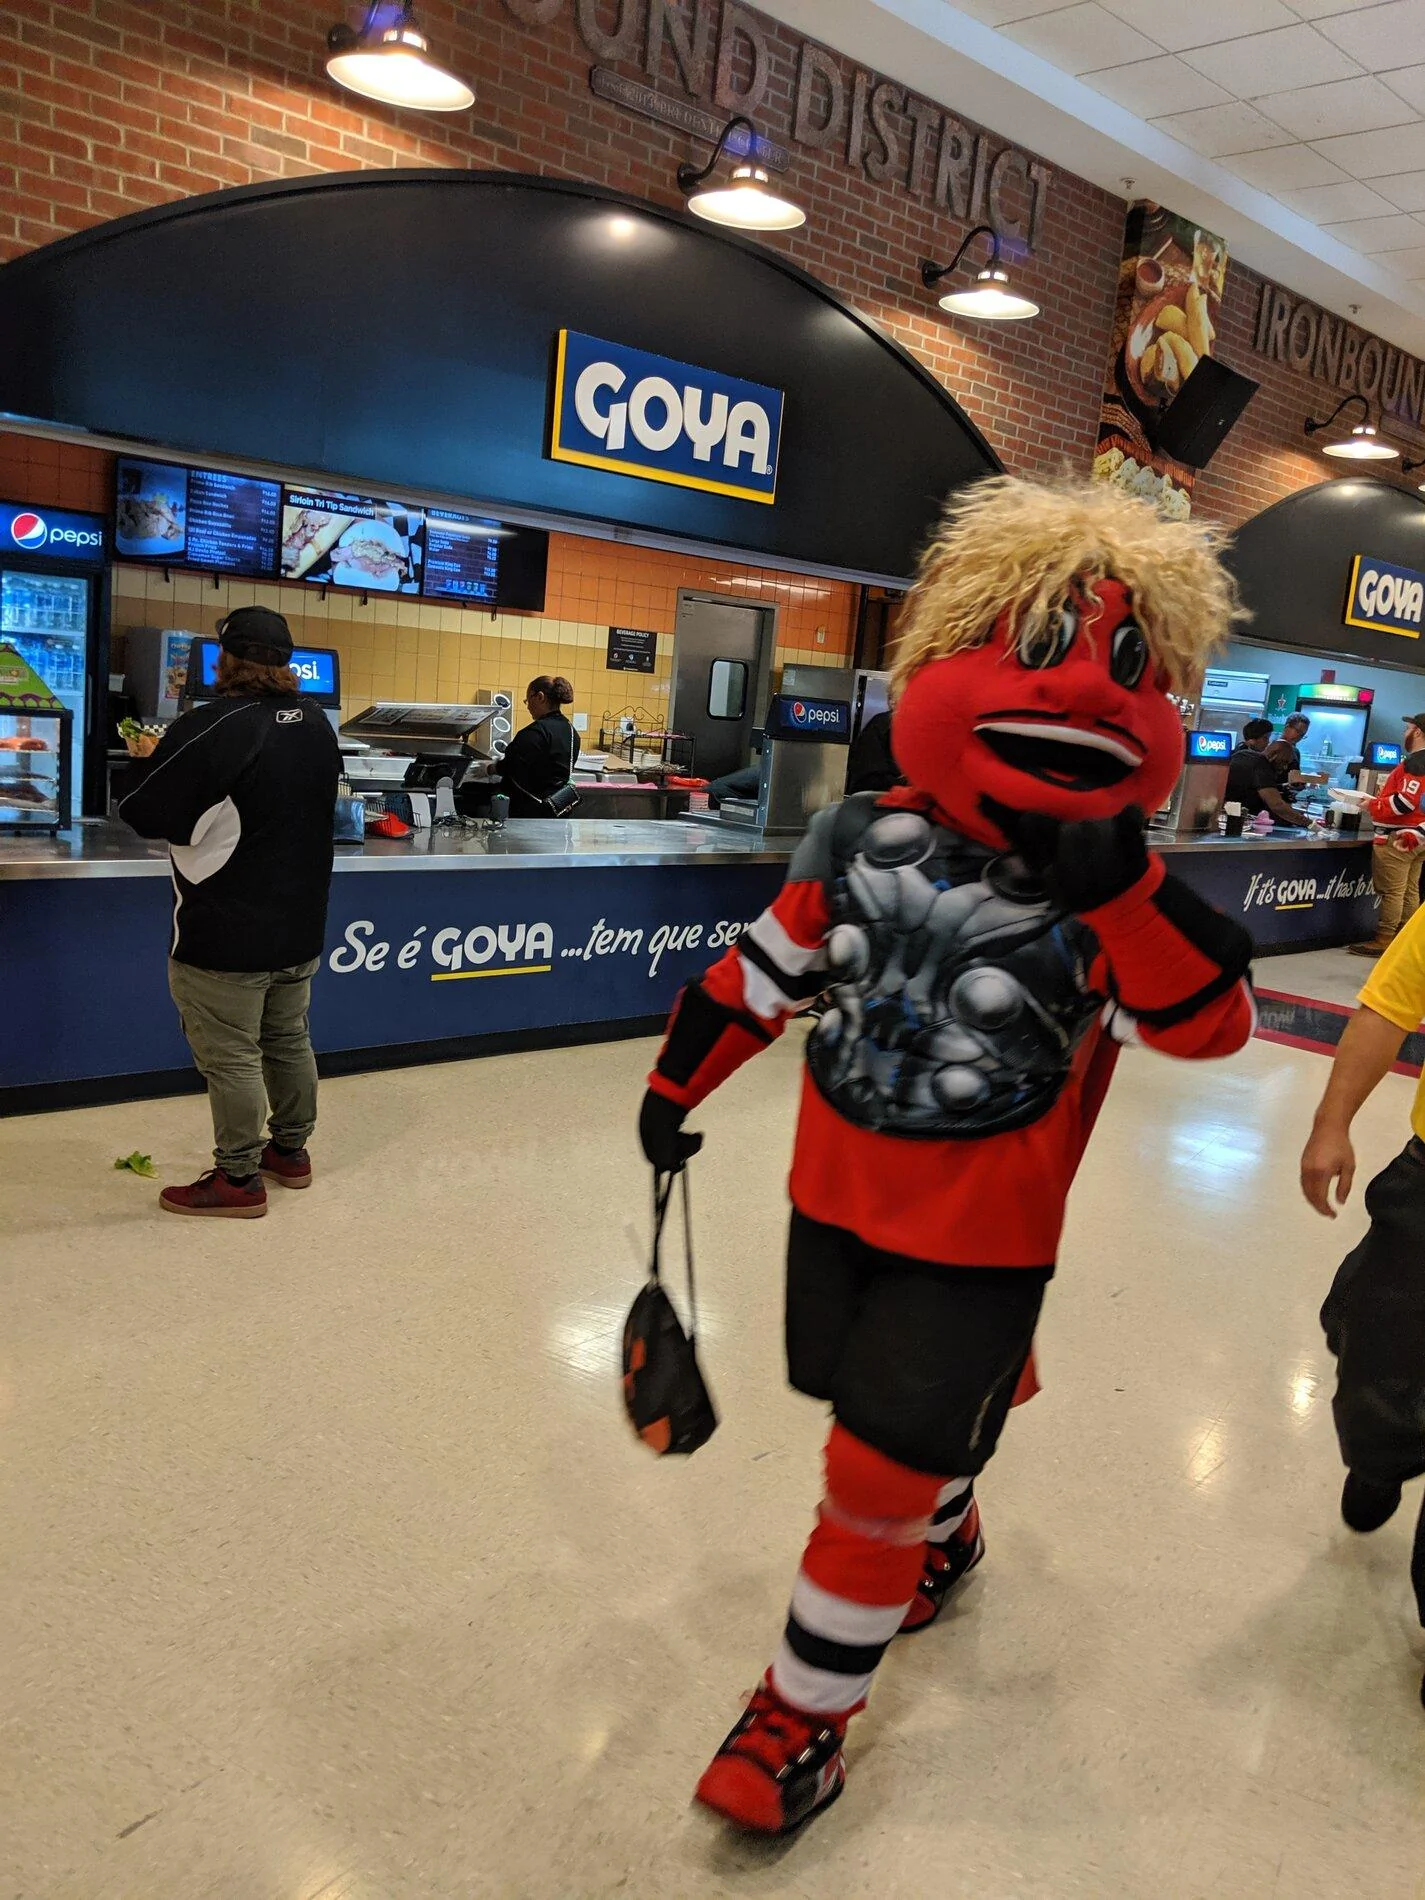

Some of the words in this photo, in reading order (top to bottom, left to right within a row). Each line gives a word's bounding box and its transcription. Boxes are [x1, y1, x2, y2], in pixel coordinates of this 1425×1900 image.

[503, 0, 770, 113] UND
[792, 41, 1053, 252] DISTRICT
[574, 361, 771, 475] GOYA
[289, 494, 314, 507] Sirloin
[314, 499, 325, 508] Tri
[325, 500, 338, 511] Tip
[338, 503, 374, 516] Sandwich
[50, 528, 103, 547] pepsi
[1358, 569, 1424, 623] GOYA
[808, 709, 839, 725] pepsi
[1207, 739, 1226, 752] pepsi
[1402, 778, 1420, 795] 19
[1243, 872, 1263, 912] If
[1276, 878, 1317, 905] GOYA
[1333, 868, 1356, 899] has
[1354, 874, 1366, 898] to
[328, 920, 390, 973] Se
[397, 925, 428, 969] é
[431, 922, 554, 971] GOYA
[648, 924, 703, 978] que
